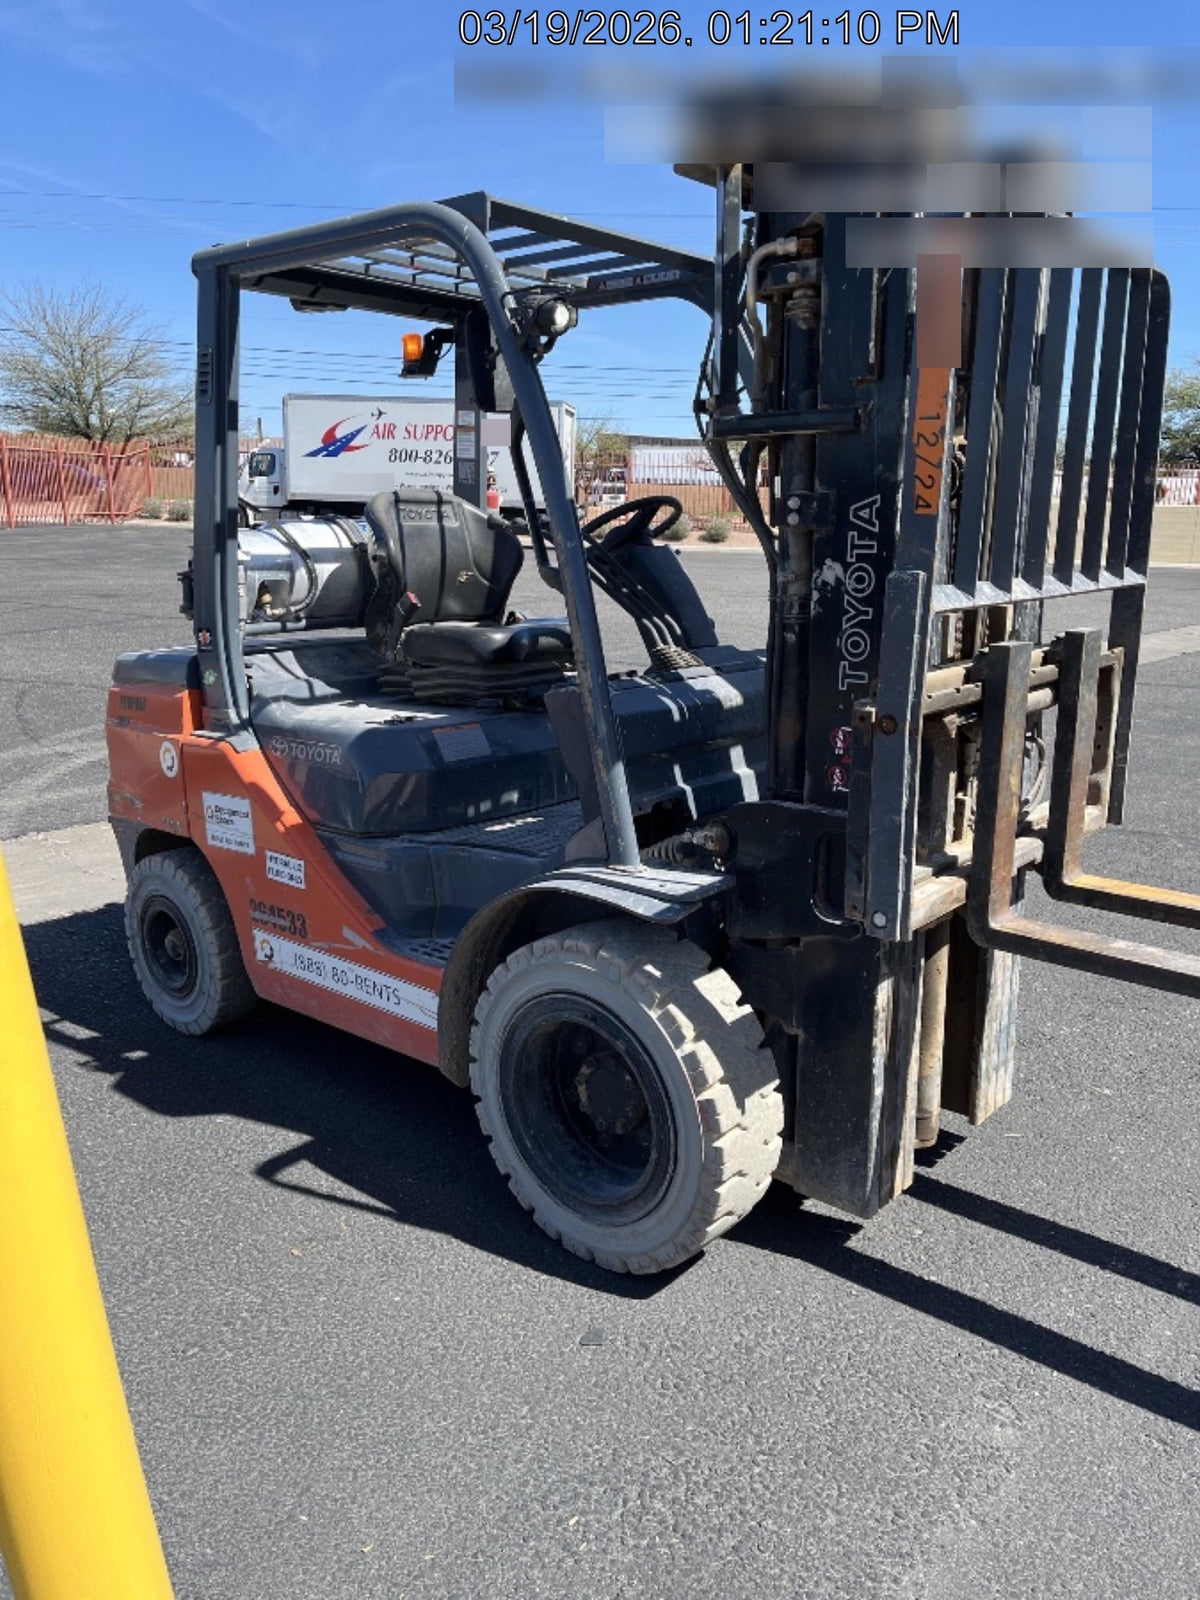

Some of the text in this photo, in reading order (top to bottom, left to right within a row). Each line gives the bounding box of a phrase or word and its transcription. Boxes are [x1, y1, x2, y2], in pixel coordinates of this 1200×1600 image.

[371, 422, 455, 441] AIR SUPPO
[914, 412, 941, 510] 12/24
[399, 506, 450, 520] TOYOTA
[839, 495, 880, 690] TOYOTA
[290, 741, 341, 766] TOYOTA
[331, 966, 401, 1006] 80-RENTS
